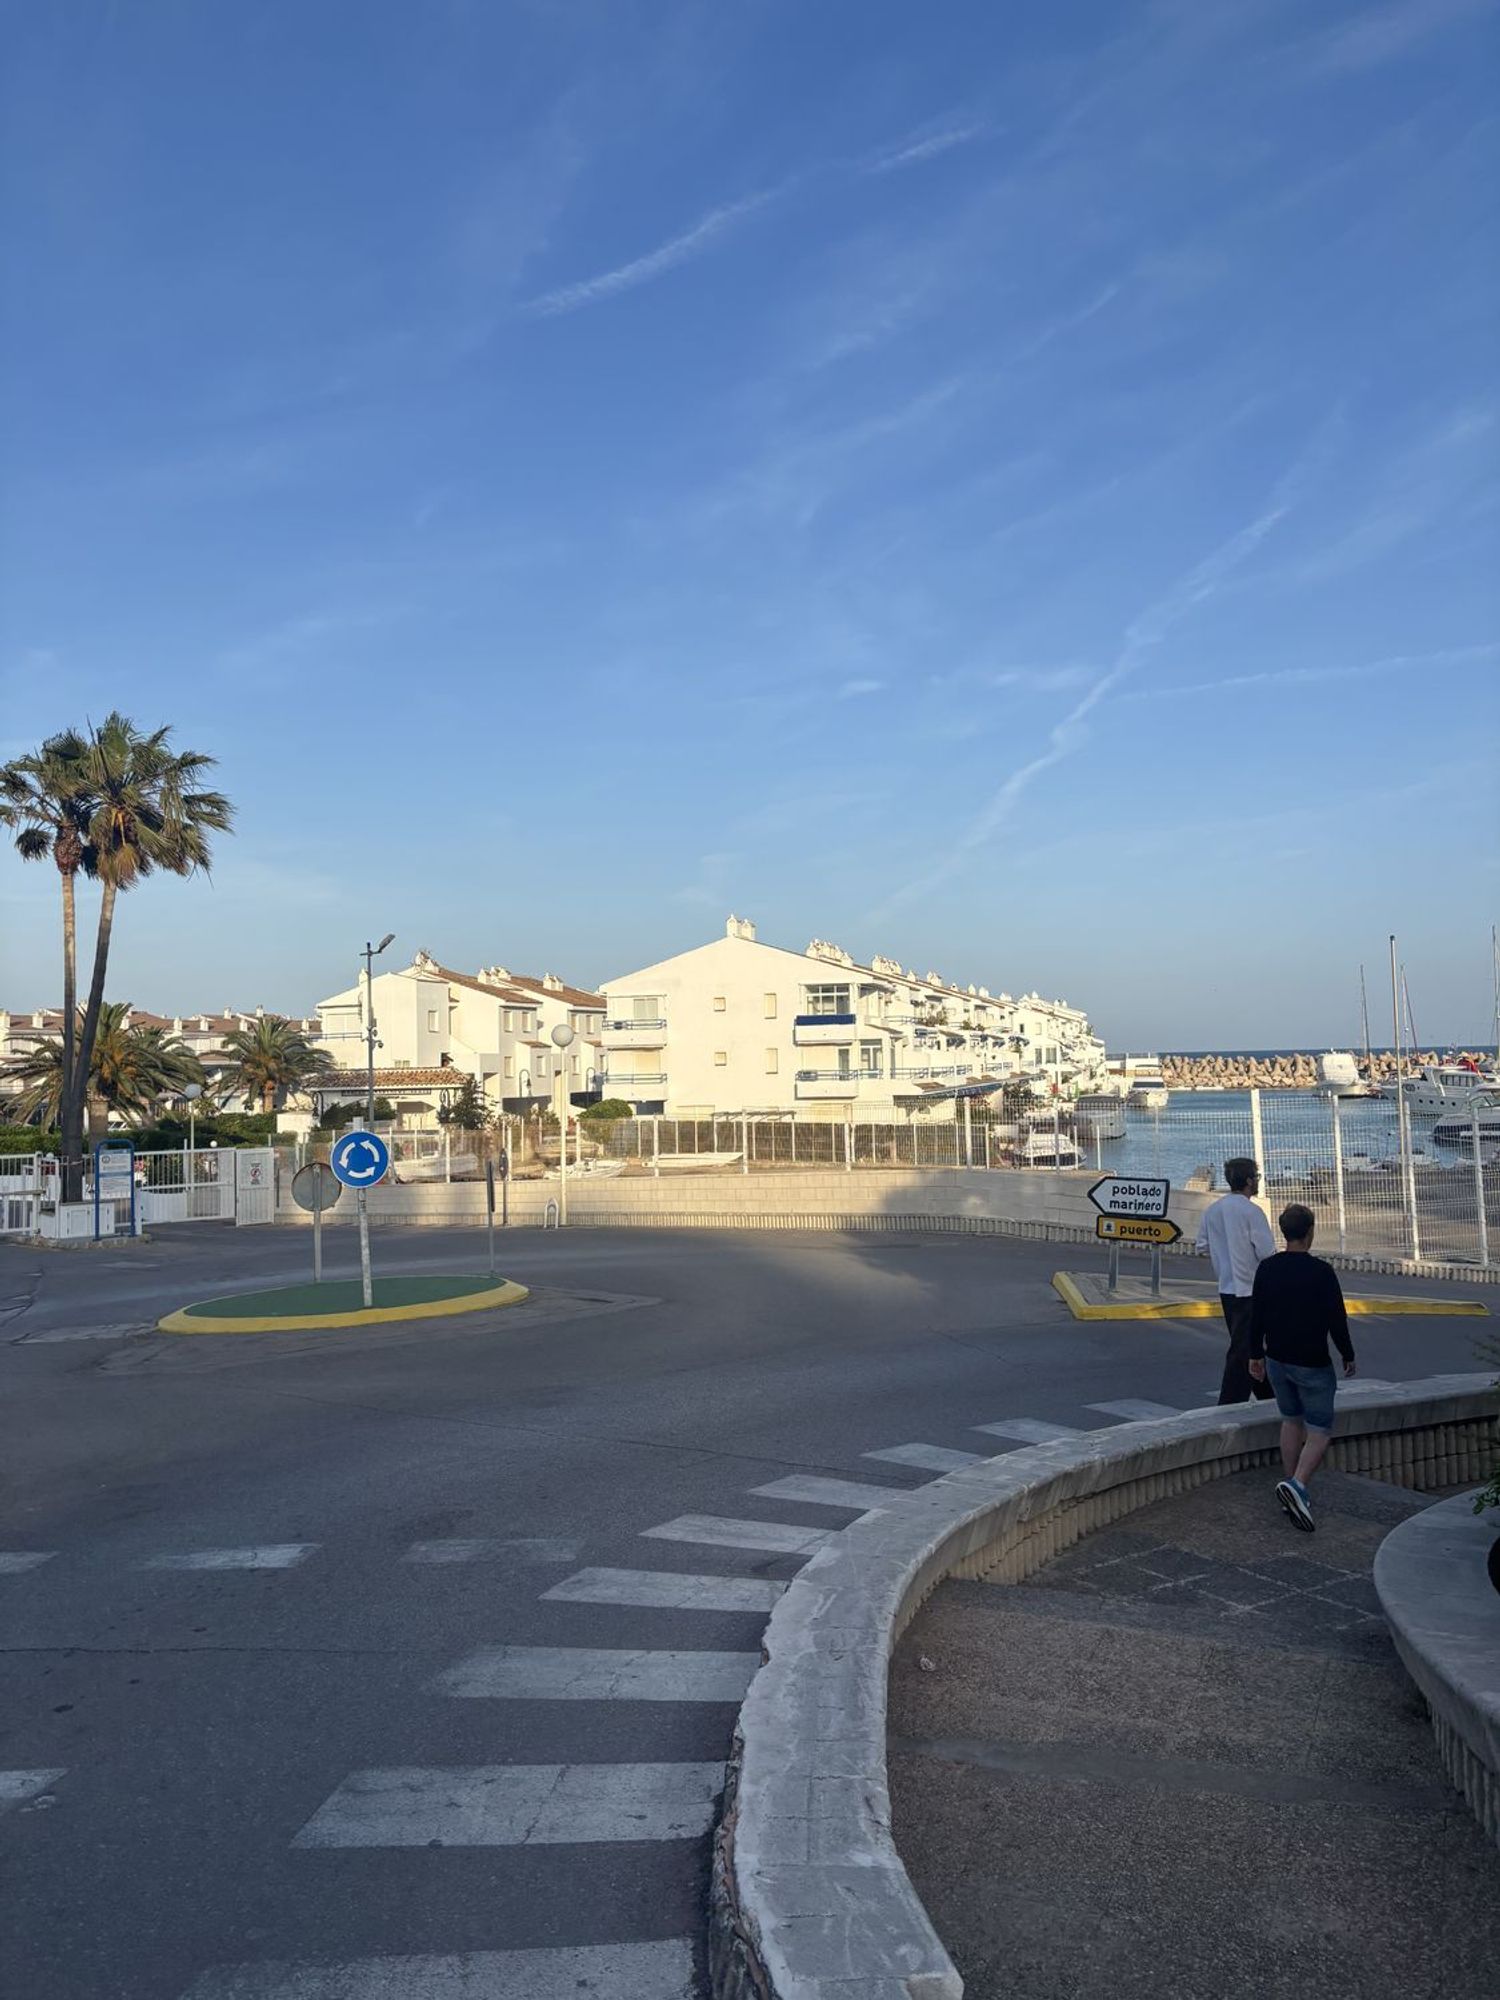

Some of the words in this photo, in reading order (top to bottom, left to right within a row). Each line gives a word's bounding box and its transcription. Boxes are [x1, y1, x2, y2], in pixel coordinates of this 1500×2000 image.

[1112, 1184, 1162, 1197] poblado
[1109, 1199, 1162, 1211] marinero
[1119, 1225, 1162, 1237] puerto
